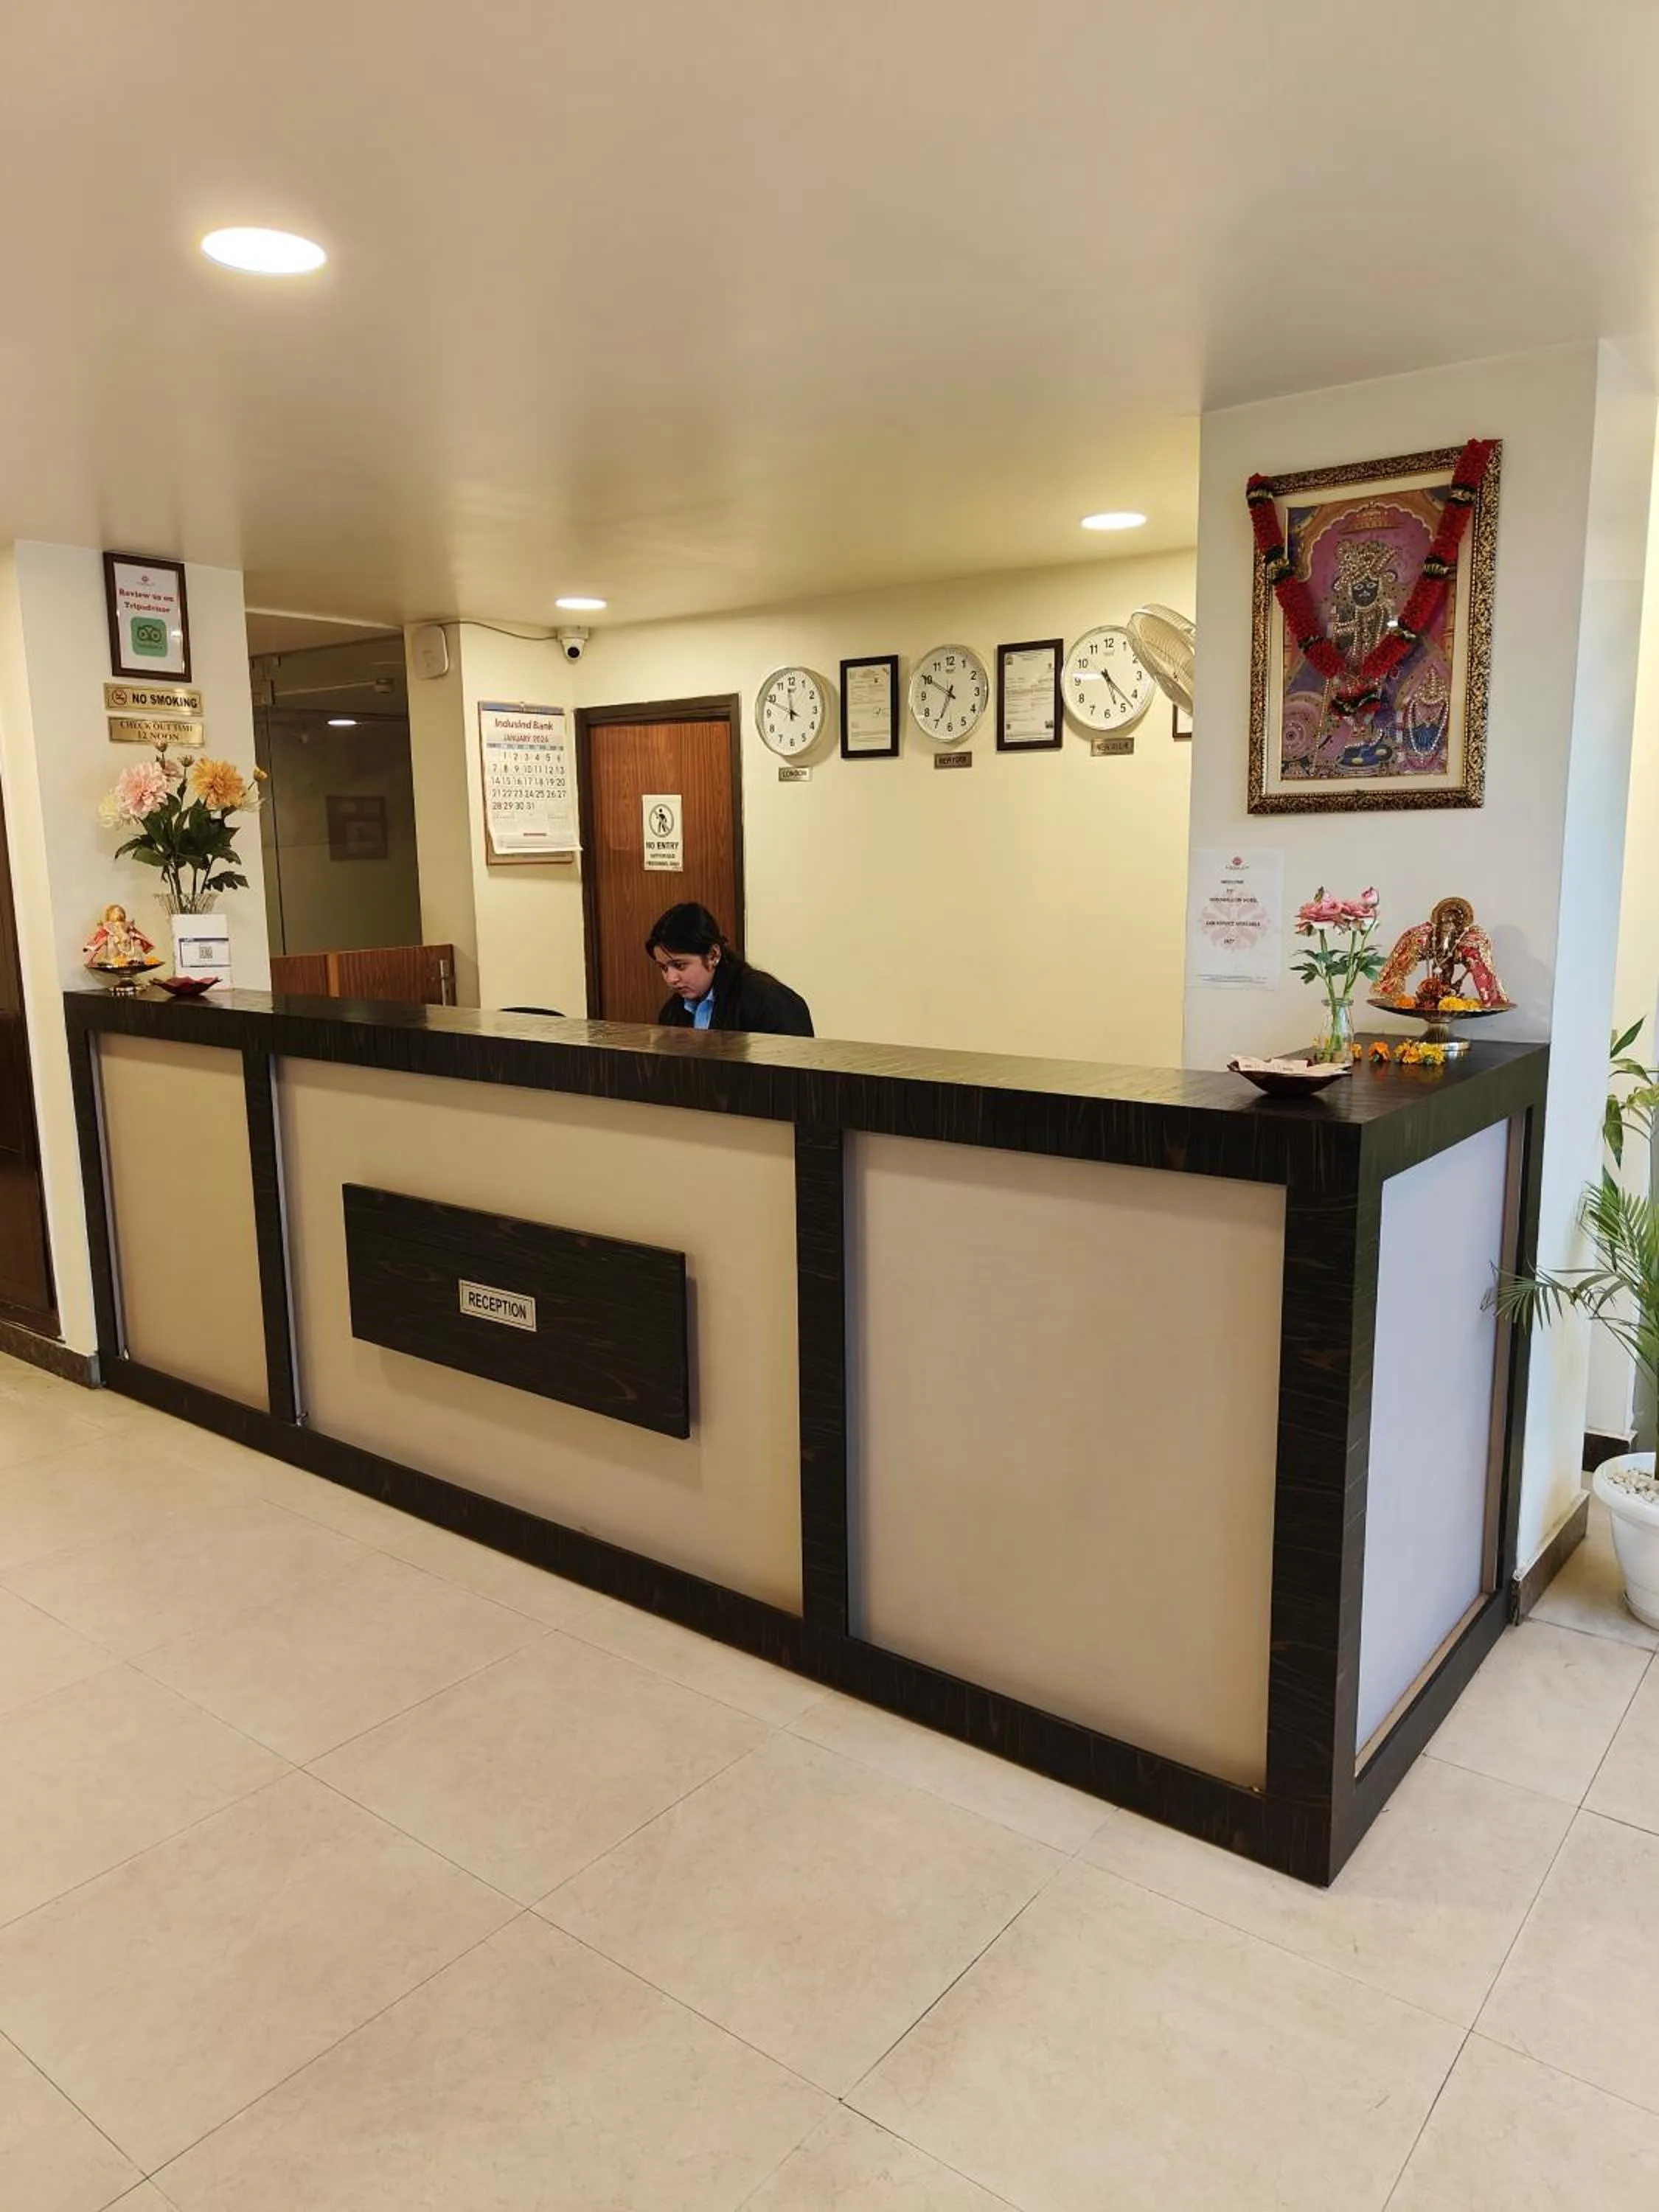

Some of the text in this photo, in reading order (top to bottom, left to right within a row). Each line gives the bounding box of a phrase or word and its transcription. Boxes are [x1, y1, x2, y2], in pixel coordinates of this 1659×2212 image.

[132, 694, 198, 708] NO SMOKING
[120, 720, 150, 730] CHECK
[153, 722, 172, 731] OUT
[495, 717, 554, 731] IndusInd Bank
[137, 731, 179, 740] 12 NOON
[524, 765, 532, 773] 10
[535, 765, 542, 773] 11
[545, 765, 554, 774] 12
[555, 766, 565, 775] 13
[782, 768, 807, 778] LONDON
[490, 776, 566, 787] 14 15 16 17 18 19 20
[493, 788, 566, 799] 21 22 23 24 25 26 27
[504, 801, 513, 810] 29
[515, 801, 524, 810] 30
[646, 841, 679, 849] NO ENTRY
[468, 1291, 526, 1319] RECEPTION
